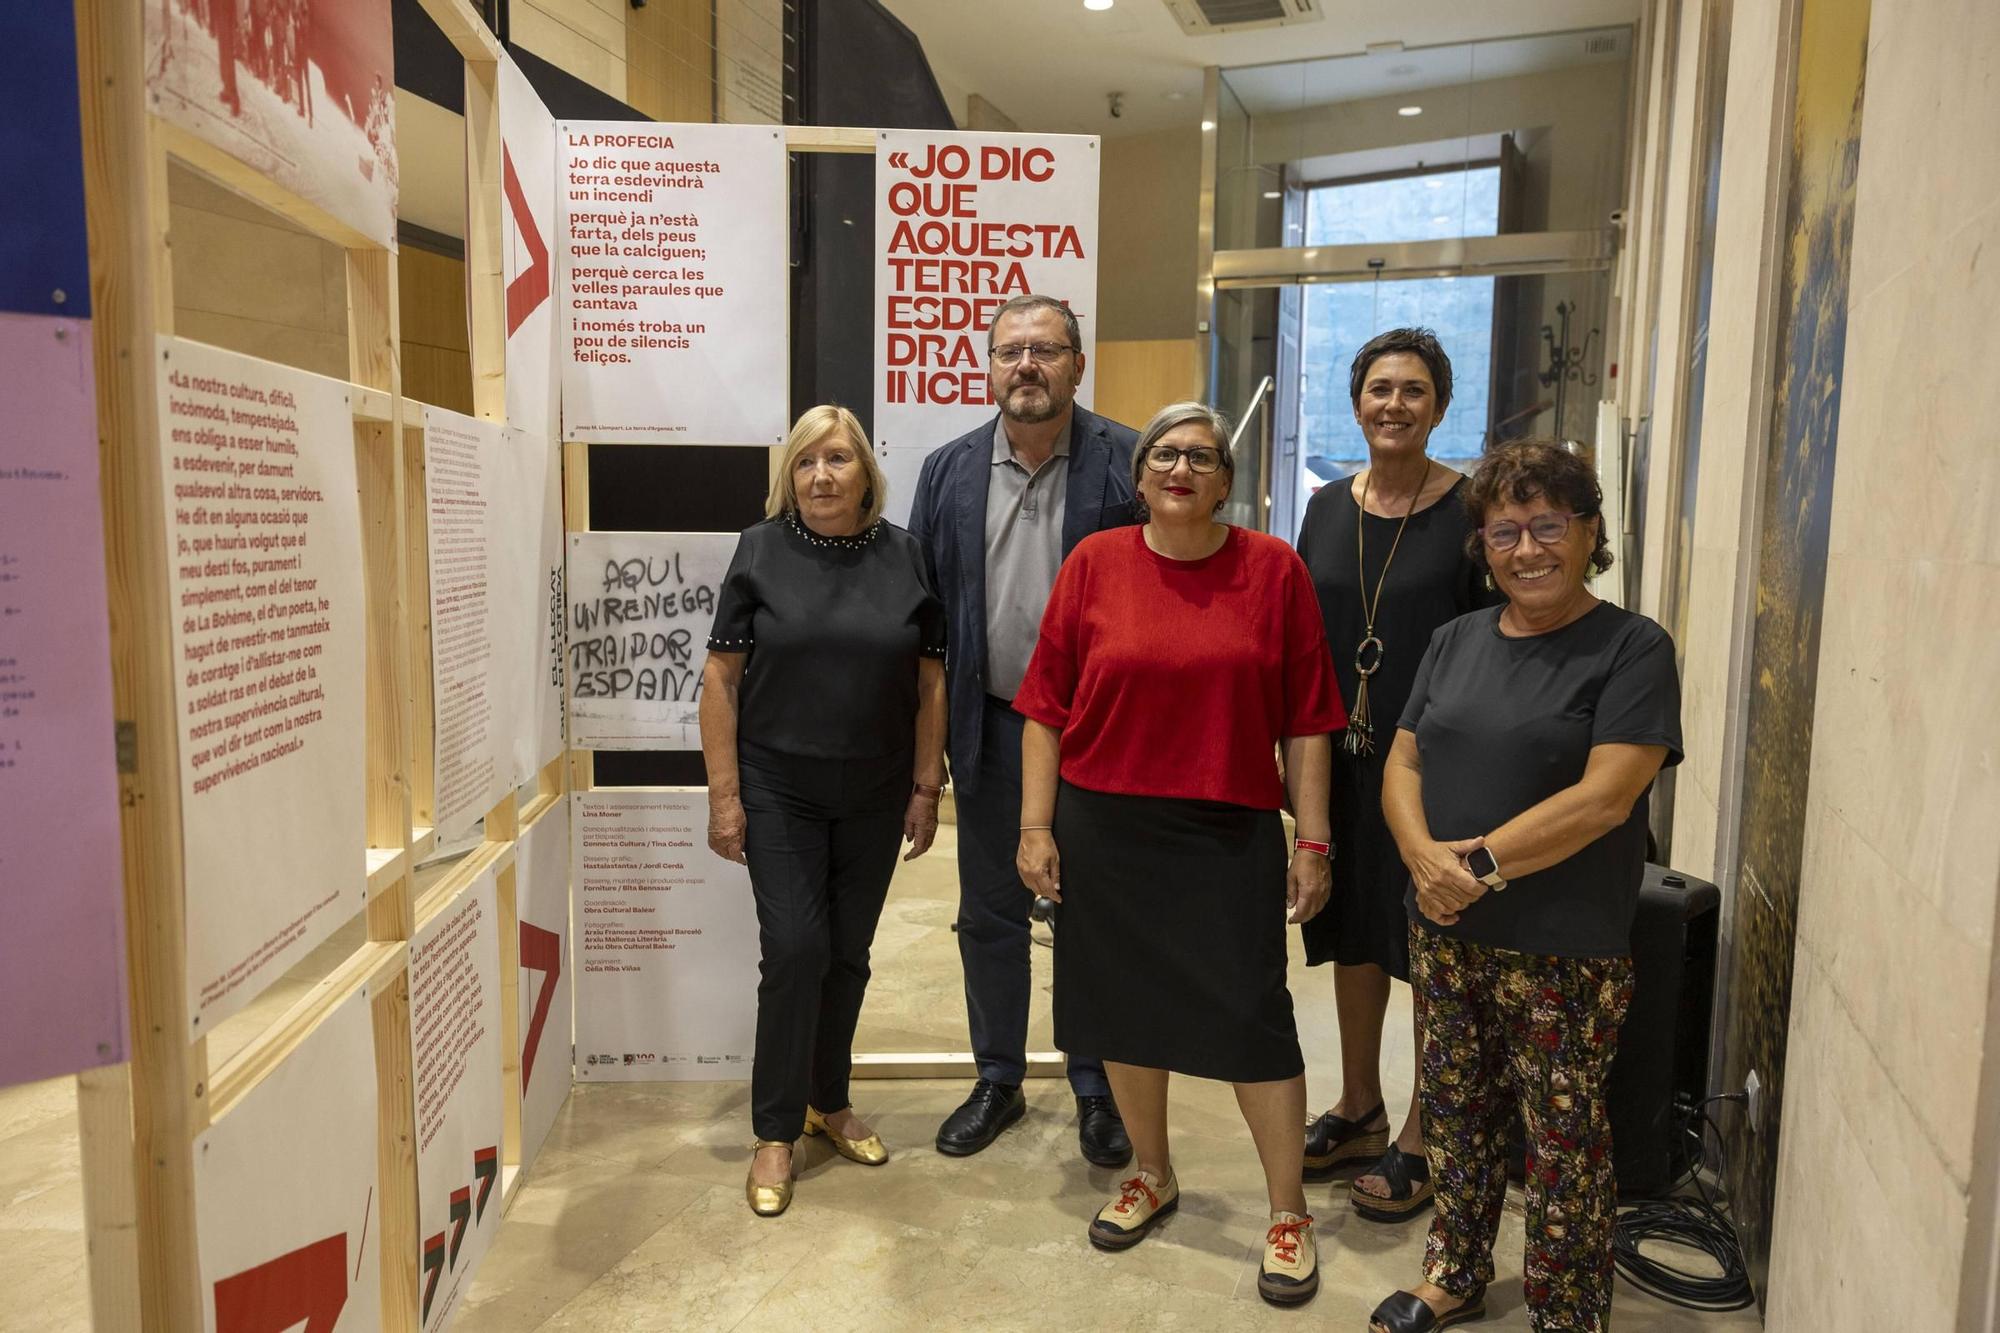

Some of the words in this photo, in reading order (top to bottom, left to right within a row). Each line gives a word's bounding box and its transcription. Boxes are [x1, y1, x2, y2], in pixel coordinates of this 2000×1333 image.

[569, 135, 589, 147] LA
[594, 136, 674, 149] PROFECIA
[569, 158, 588, 169] Jo
[593, 157, 617, 169] dic
[621, 161, 651, 172] que
[655, 161, 721, 175] aquesta
[888, 144, 971, 180] «JO
[981, 146, 1056, 183] DIC
[569, 173, 610, 185] terra
[614, 174, 704, 189] esdevindrà
[570, 191, 589, 201] un
[594, 188, 653, 203] incendi
[888, 182, 977, 218] QUE
[570, 212, 627, 226] perquè
[631, 212, 646, 227] ja
[570, 227, 618, 242] farta,
[621, 228, 654, 241] dels
[659, 233, 696, 245] peus
[888, 221, 1085, 259] AQUESTA
[571, 245, 601, 258] que
[605, 244, 619, 256] la
[623, 244, 706, 261] calciguen;
[572, 266, 629, 281] perquè
[633, 269, 678, 280] cerca
[682, 268, 704, 280] les
[888, 258, 1032, 295] TERRA
[572, 281, 618, 294] velles
[622, 283, 691, 297] paraules
[695, 286, 724, 299] que
[573, 298, 638, 310] cantava
[573, 318, 577, 331] i
[582, 320, 635, 332] només
[639, 321, 682, 333] troba
[686, 324, 705, 333] un
[574, 337, 603, 349] pou
[608, 336, 627, 347] de
[631, 336, 690, 349] silencis
[888, 329, 979, 368] DRÀ
[574, 350, 632, 366] feliços.
[192, 375, 228, 396] nostra
[230, 383, 267, 407] cultura,
[887, 371, 996, 405] INCE
[170, 395, 230, 426] incòmoda,
[232, 408, 299, 435] tempestejada,
[172, 428, 192, 443] ens
[195, 427, 227, 451] obliga
[230, 436, 236, 448] a
[238, 437, 264, 451] esser
[266, 435, 299, 458] humils,
[174, 457, 180, 470] a
[183, 454, 238, 478] esdevenir,
[239, 462, 256, 478] per
[258, 460, 294, 478] damunt
[175, 481, 226, 502] qualsevol
[228, 483, 251, 500] altra
[254, 488, 280, 504] cosa,
[281, 486, 324, 502] servidors.
[176, 508, 190, 525] He
[193, 507, 207, 525] dit
[210, 513, 223, 524] en
[225, 508, 258, 529] alguna
[260, 508, 291, 524] ocasió
[292, 513, 308, 527] que
[180, 565, 202, 580] meu
[232, 559, 250, 577] fos,
[252, 558, 297, 577] purament
[298, 554, 302, 569] i
[603, 552, 684, 593] AQUI
[182, 584, 244, 610] simplement,
[245, 584, 267, 598] com
[269, 580, 277, 596] el
[279, 579, 292, 594] del
[294, 579, 317, 592] tenor
[575, 598, 600, 632] UN
[184, 639, 214, 662] hagut
[216, 637, 229, 652] de
[231, 628, 285, 650] revestir-me
[287, 618, 330, 639] tanmateix
[569, 629, 692, 670] TRAIDOR
[186, 670, 199, 688] de
[201, 662, 240, 681] coratge
[241, 657, 244, 673] i
[303, 644, 322, 658] com
[552, 658, 557, 686] EL
[190, 718, 223, 741] nostra
[224, 694, 288, 729] supervivència
[289, 684, 325, 707] cultural,
[192, 750, 210, 771] que
[212, 739, 227, 759] vol
[228, 734, 242, 753] dir
[244, 728, 263, 747] tant
[264, 723, 284, 740] com
[285, 717, 293, 732] la
[294, 710, 322, 729] nostra
[193, 754, 260, 795] supervivència
